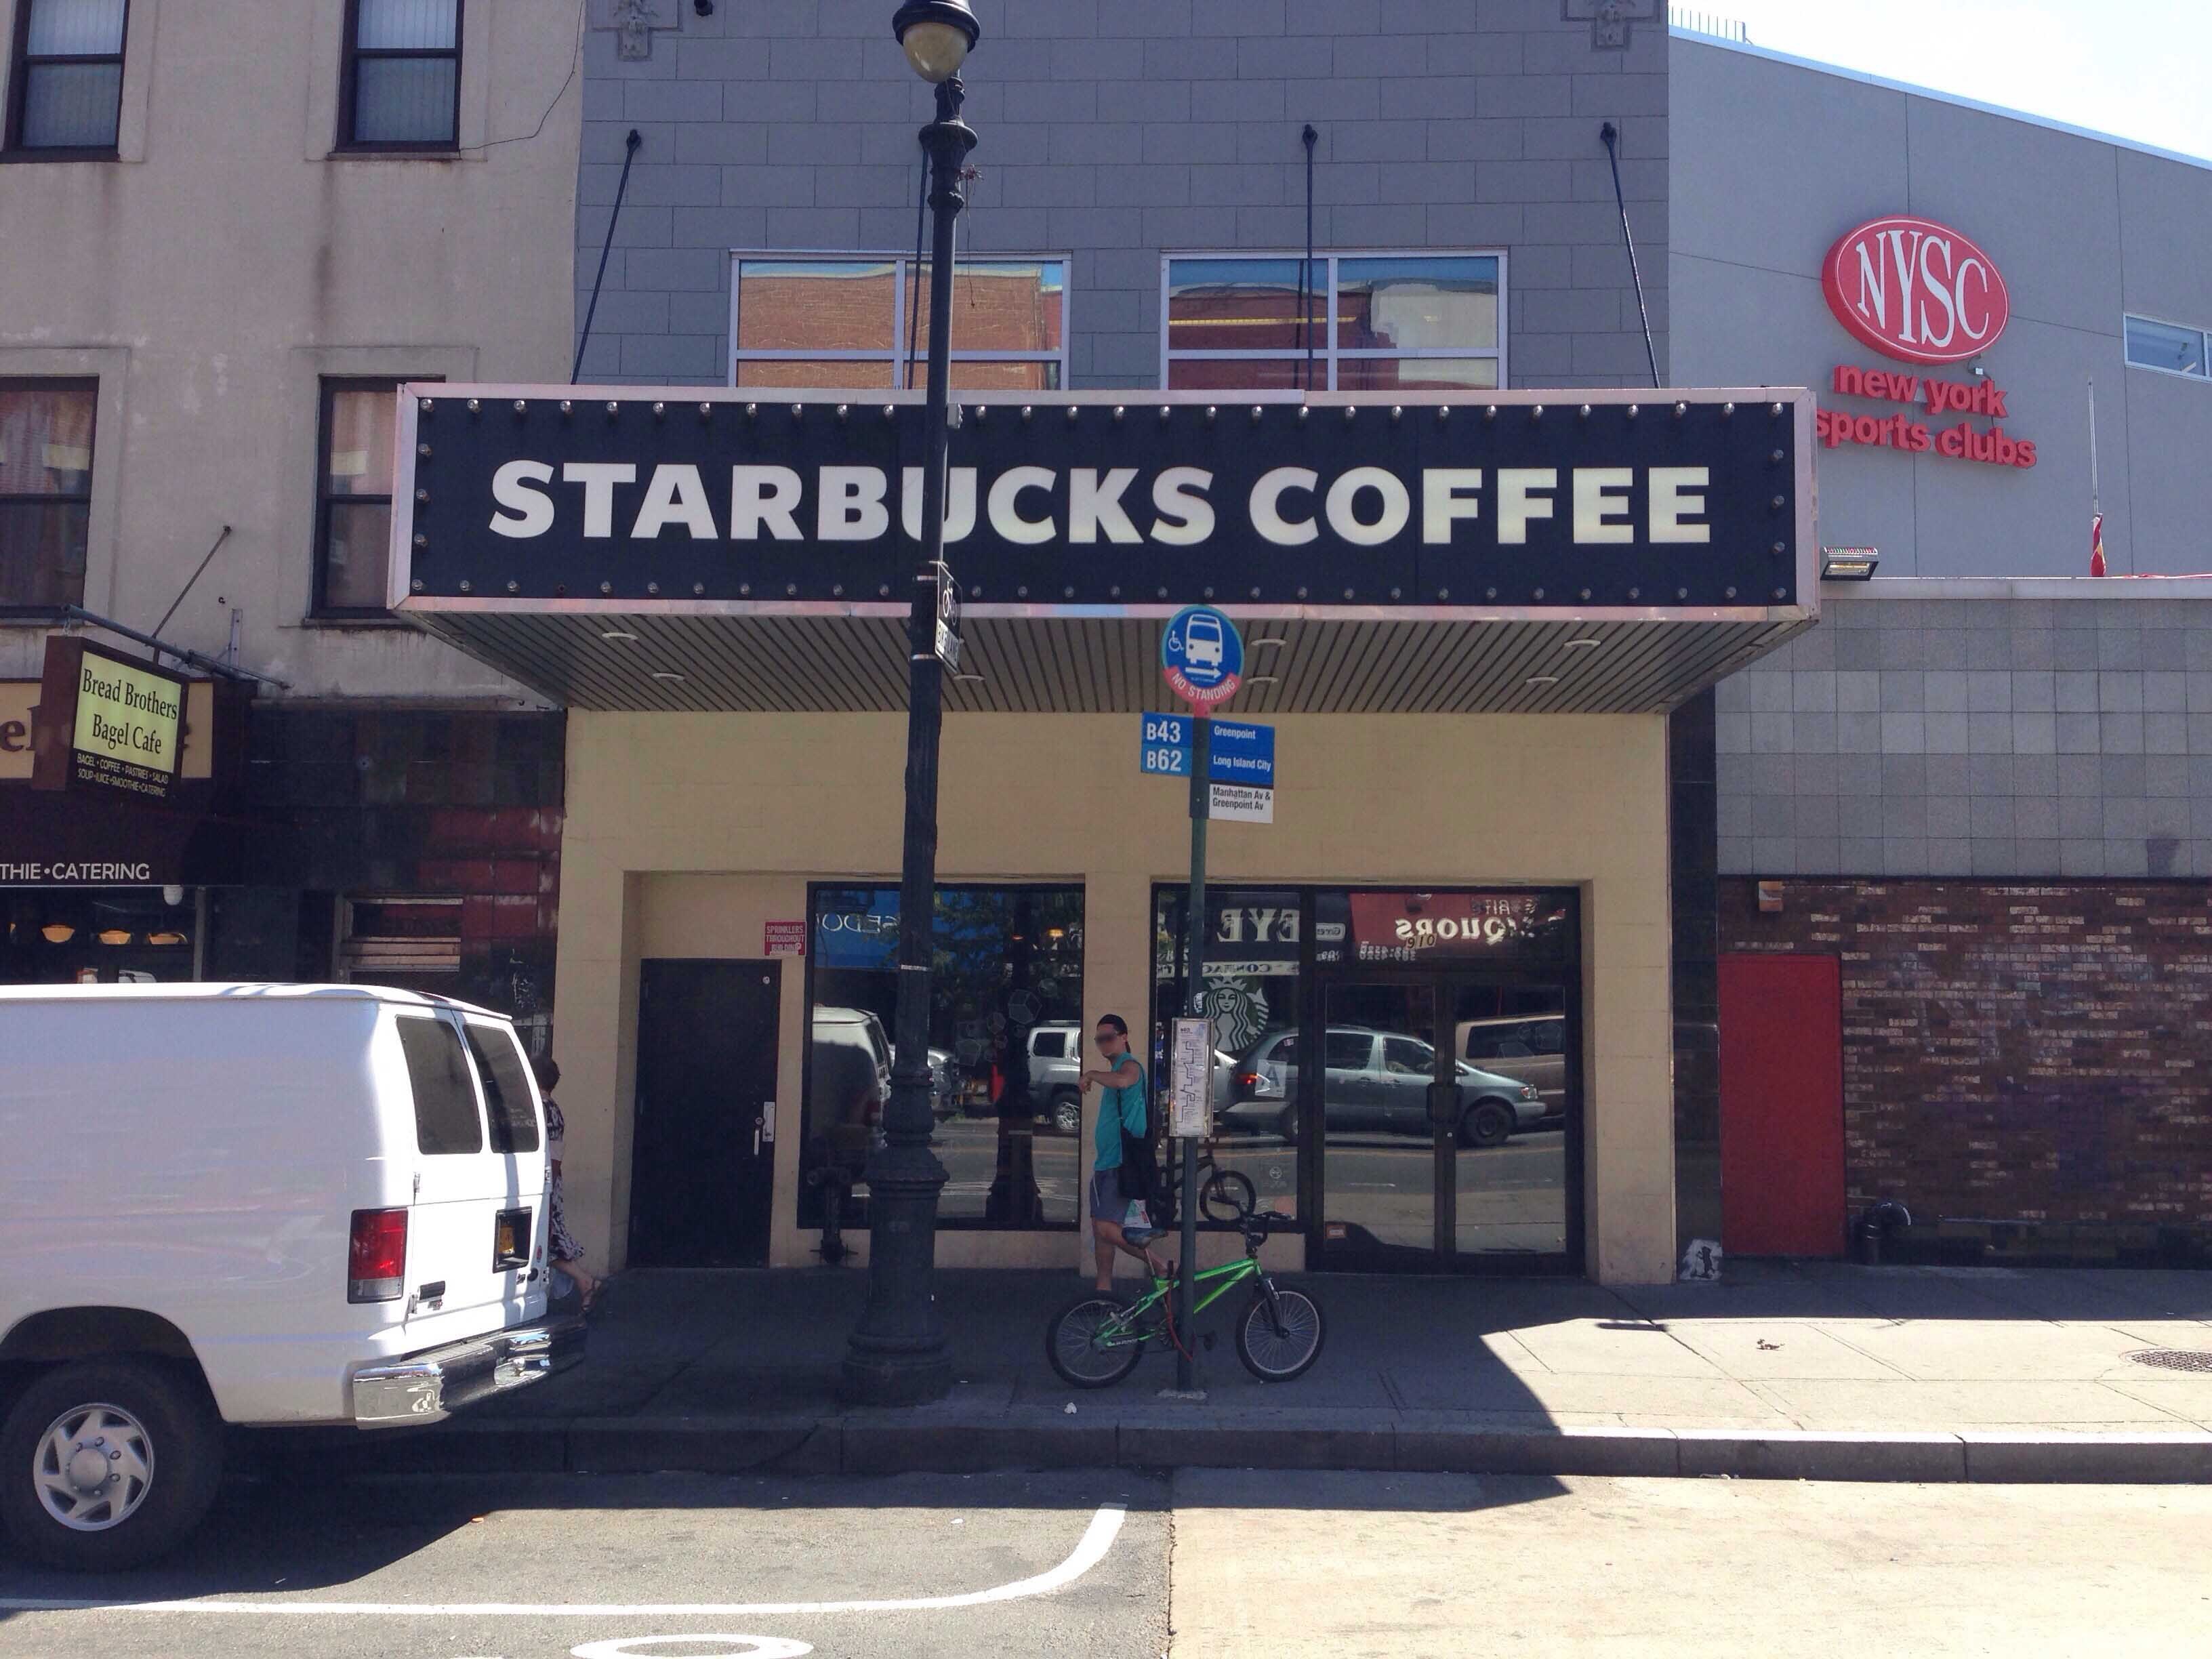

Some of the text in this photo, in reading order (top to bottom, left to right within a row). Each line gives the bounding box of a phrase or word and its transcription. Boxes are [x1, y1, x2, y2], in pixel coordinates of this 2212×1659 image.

[1856, 230, 1989, 348] NYSC
[1835, 365, 2008, 418] new york
[1816, 407, 2037, 469] sports clubs
[489, 459, 1711, 546] STARBUCKS COFFEE
[82, 668, 178, 720] Bread Brothers
[1172, 672, 1235, 700] NO STANDING
[92, 713, 129, 750] Bagel
[133, 726, 163, 754] Cafe
[1147, 720, 1181, 743] B43
[1214, 725, 1256, 739] Greenpoint
[100, 758, 121, 773] COFFEE
[1147, 748, 1182, 772] B62
[1213, 755, 1271, 773] Long Island City
[1212, 798, 1264, 811] Greenpoint Av
[1213, 787, 1271, 800] Manhattan Av &
[52, 863, 150, 880] CATERING
[766, 925, 803, 934] SPRINKLERS
[766, 934, 805, 943] THROUGHOUT
[1408, 935, 1435, 949] 910
[1262, 1065, 1280, 1088] A
